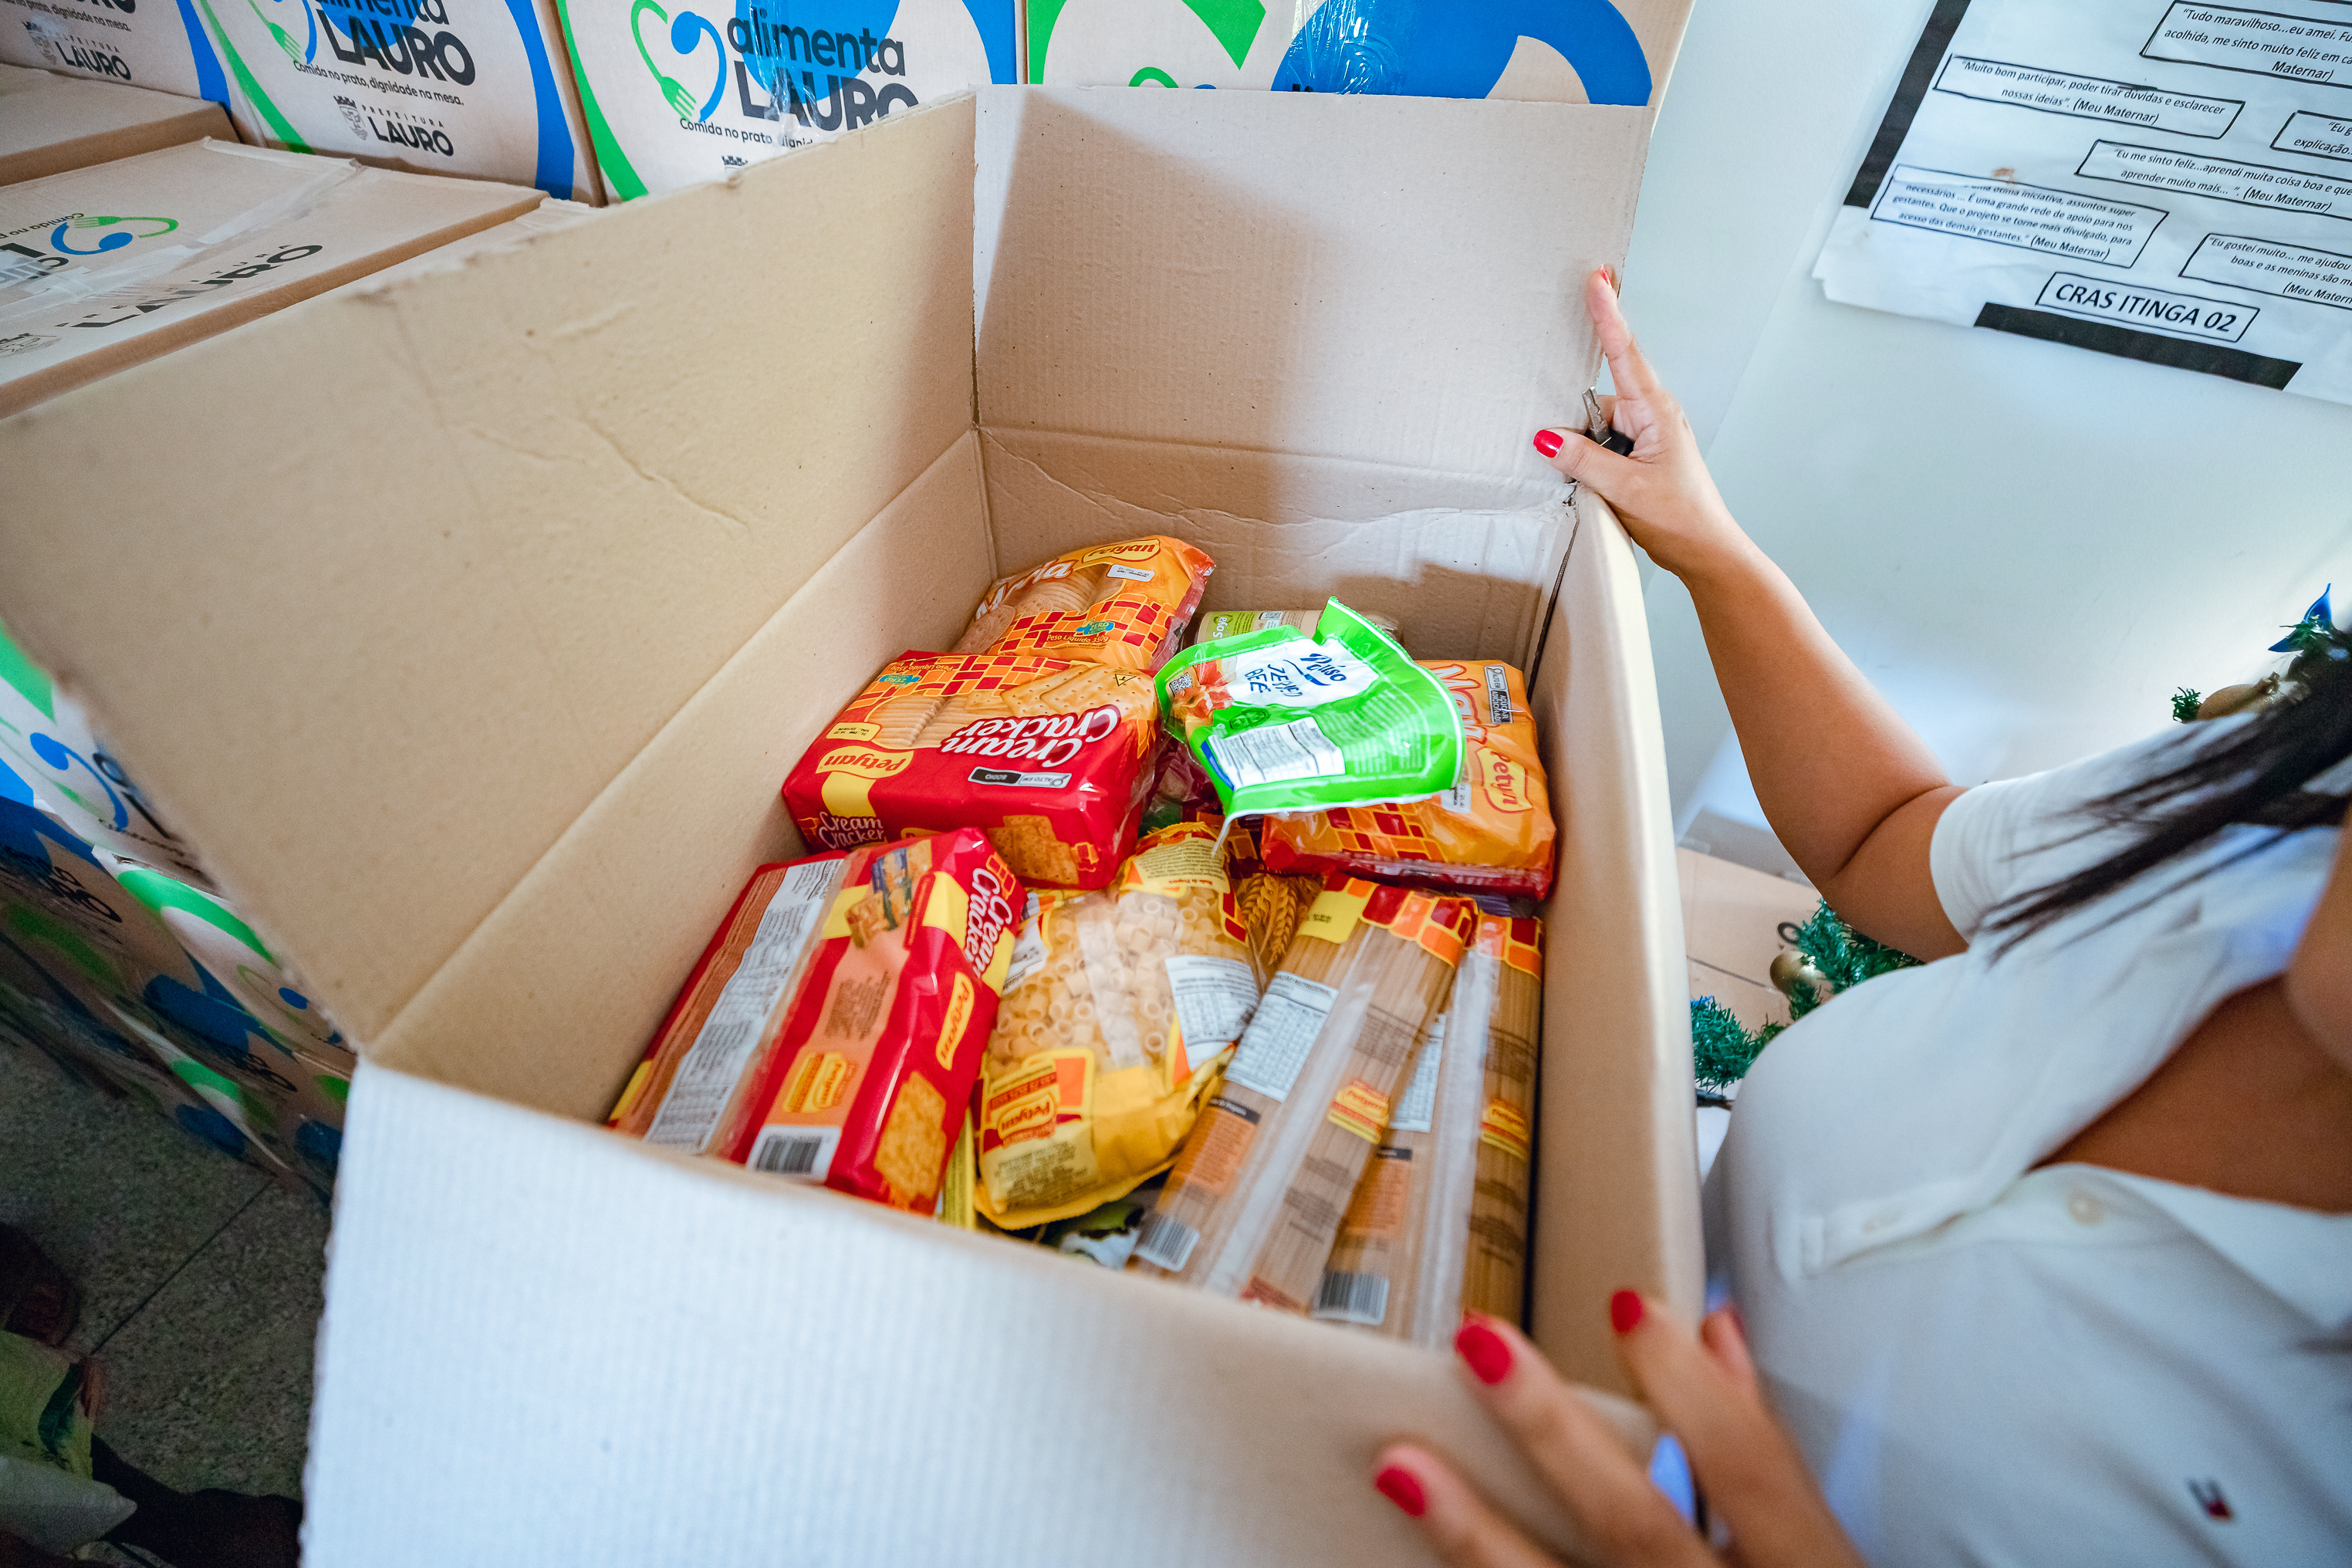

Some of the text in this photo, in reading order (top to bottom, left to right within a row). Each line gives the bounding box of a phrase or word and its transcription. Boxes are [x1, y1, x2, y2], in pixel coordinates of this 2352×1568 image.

[52, 4, 94, 23] dignidade
[93, 15, 106, 26] na
[105, 19, 132, 32] mesa.
[316, 8, 476, 86] LAURO
[727, 5, 906, 76] alimenta
[2164, 29, 2209, 45] acolhida,
[2212, 37, 2230, 46] me
[2231, 38, 2259, 50] sinto
[2261, 44, 2294, 56] muito
[2296, 46, 2320, 59] feliz
[2321, 53, 2340, 63] em
[2306, 27, 2337, 40] amei.
[2339, 31, 2352, 42] Fu
[55, 41, 131, 80] LAURO
[2272, 61, 2335, 83] Maternar)
[293, 59, 465, 106] Comida no prato, dignidade na mesa.
[1995, 66, 2016, 77] bom
[2017, 73, 2066, 88] participar,
[2068, 80, 2099, 92] poder
[2100, 84, 2124, 97] tirar
[2124, 88, 2162, 104] dúvidas
[2174, 99, 2225, 115] esclarecer
[361, 104, 444, 128] PREFEITURA
[2001, 89, 2033, 101] nossas
[2073, 97, 2102, 113] (Meu
[2104, 104, 2160, 126] Maternar)
[367, 116, 455, 157] LAURO
[679, 117, 723, 136] Comida
[724, 127, 740, 139] no
[2148, 155, 2172, 166] sinto
[2243, 171, 2274, 183] muita
[2275, 176, 2302, 188] coisa
[2303, 179, 2323, 192] boa
[2021, 189, 2063, 206] iniciativa,
[2066, 199, 2107, 212] assuntos
[2109, 207, 2136, 218] super
[2121, 169, 2167, 184] aprender
[2167, 178, 2196, 189] muito
[2243, 186, 2274, 202] (Meu
[2274, 193, 2333, 214] Maternar)
[29, 213, 84, 230] Comida
[1892, 195, 1936, 211] gestantes.
[1939, 203, 1958, 215] Que
[1965, 209, 2000, 222] projeto
[2013, 218, 2039, 228] torne
[2039, 221, 2060, 232] mais
[2063, 225, 2108, 242] divulgado,
[2110, 235, 2132, 246] para
[1905, 184, 1955, 200] necessários
[1975, 197, 1995, 207] uma
[1996, 201, 2029, 213] grande
[2030, 207, 2052, 216] rede
[2053, 211, 2065, 219] de
[2066, 213, 2093, 225] apoio
[2093, 218, 2114, 229] para
[2116, 222, 2133, 231] nos
[1898, 212, 1928, 224] acesso
[1928, 217, 1944, 228] das
[1945, 221, 1976, 233] demais
[2030, 235, 2057, 249] (Meu
[2060, 241, 2110, 262] Maternar)
[2223, 241, 2256, 253] gostei
[2296, 255, 2314, 264] me
[2315, 258, 2351, 270] ajudou
[2231, 255, 2255, 268] boas
[2264, 263, 2276, 272] as
[2277, 265, 2320, 280] meninas
[2320, 273, 2339, 283] são
[2056, 283, 2238, 333] CRAS ITINGA 02
[2283, 282, 2352, 305] (Meu Matern
[1090, 621, 1109, 631] ZERO
[1091, 634, 1109, 644] 350g
[1212, 617, 1228, 639] Soya
[956, 708, 1118, 742] Cracker
[824, 753, 907, 772] Petyan
[941, 737, 1083, 768] Cream
[819, 811, 884, 831] Cream
[818, 826, 885, 849] Cracker
